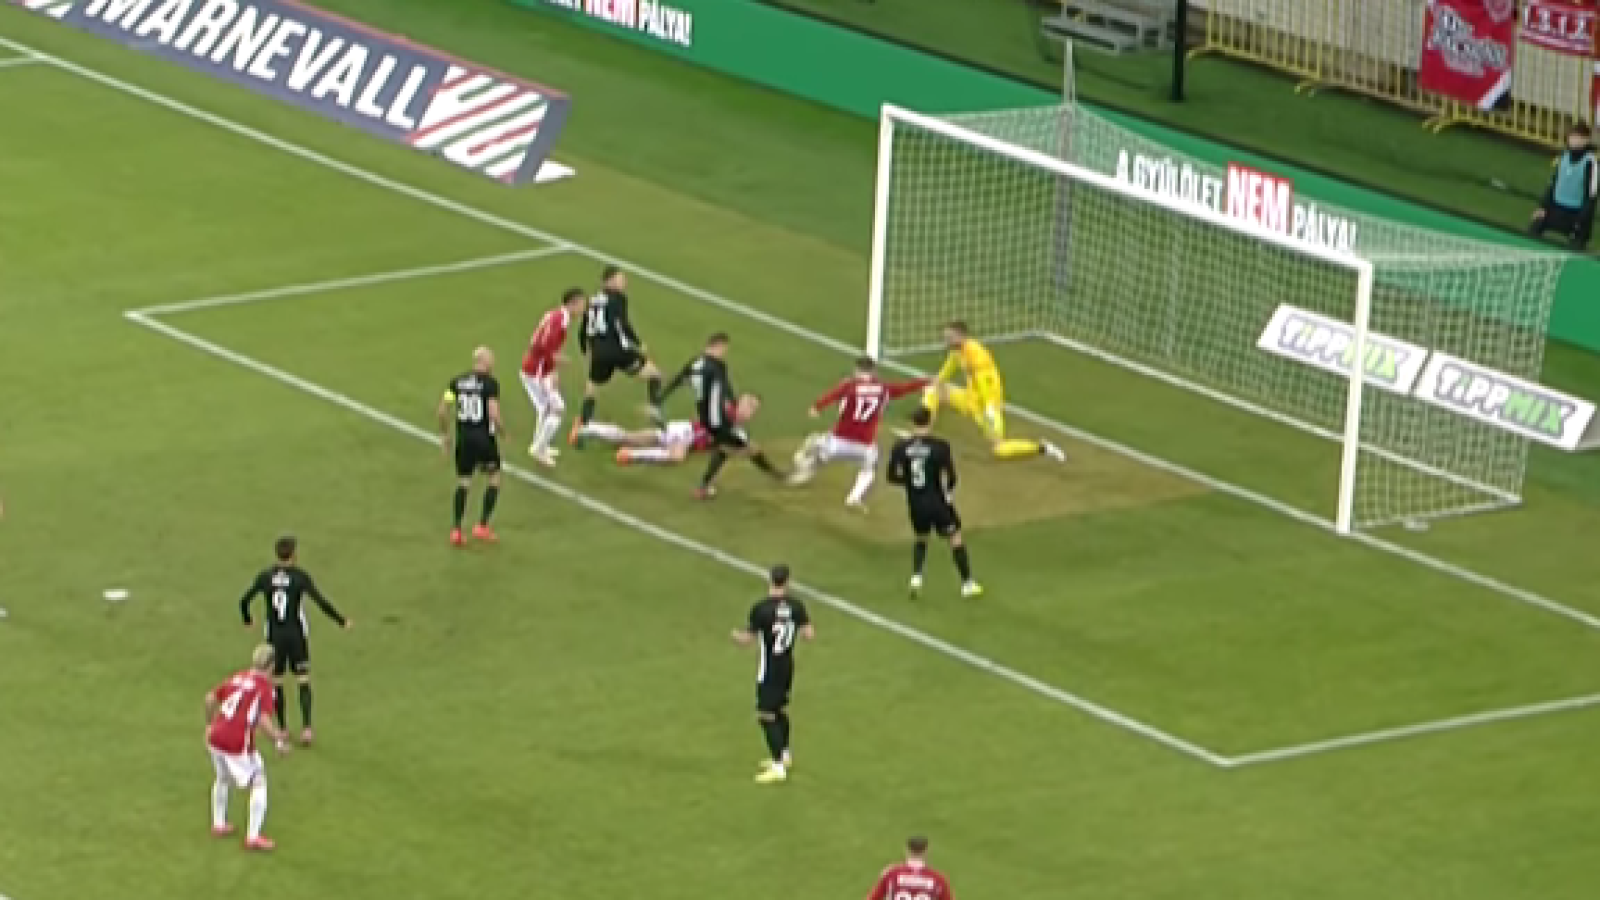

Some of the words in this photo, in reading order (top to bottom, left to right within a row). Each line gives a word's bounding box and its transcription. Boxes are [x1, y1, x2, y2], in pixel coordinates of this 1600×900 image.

[1229, 166, 1291, 236] NEM
[457, 393, 484, 423] 30
[854, 396, 879, 421] 17
[272, 590, 288, 622] 9
[220, 689, 243, 719] 4
